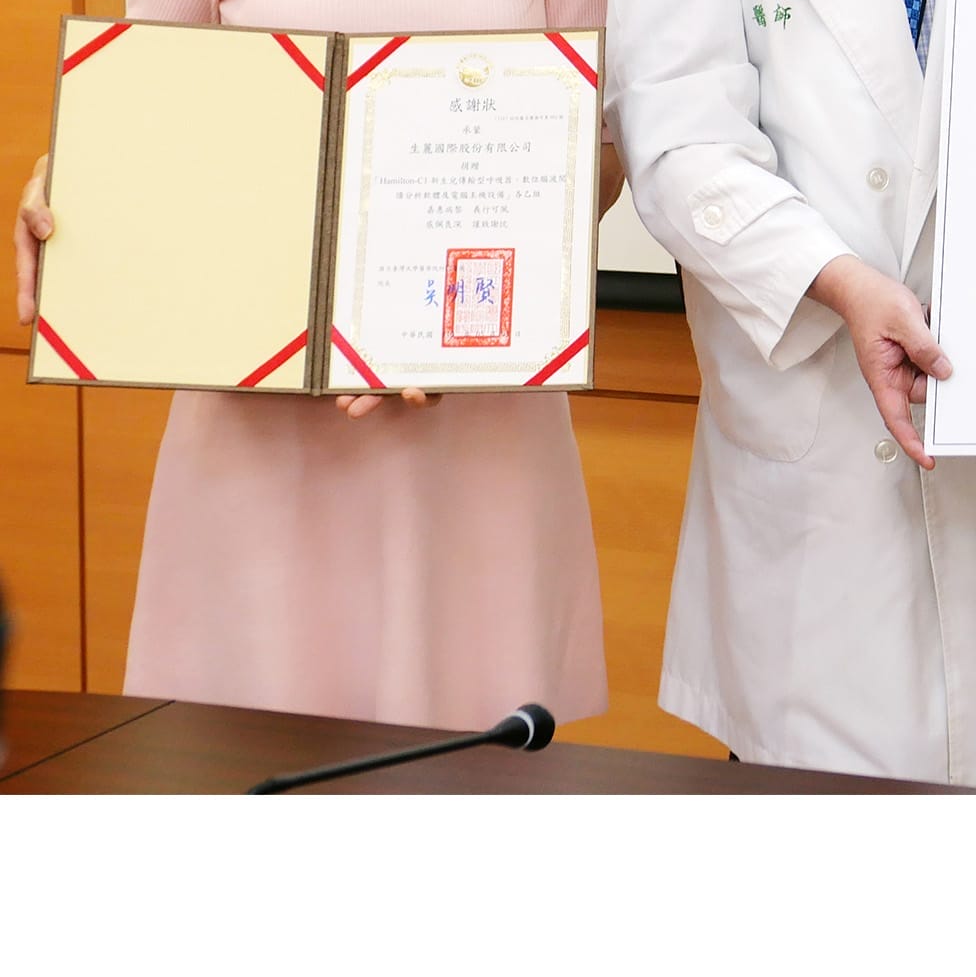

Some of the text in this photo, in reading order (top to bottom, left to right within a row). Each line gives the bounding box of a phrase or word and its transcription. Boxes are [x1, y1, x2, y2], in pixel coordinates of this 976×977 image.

[449, 98, 497, 113] 感謝狀
[410, 142, 532, 154] 生麗國際股份有限公司
